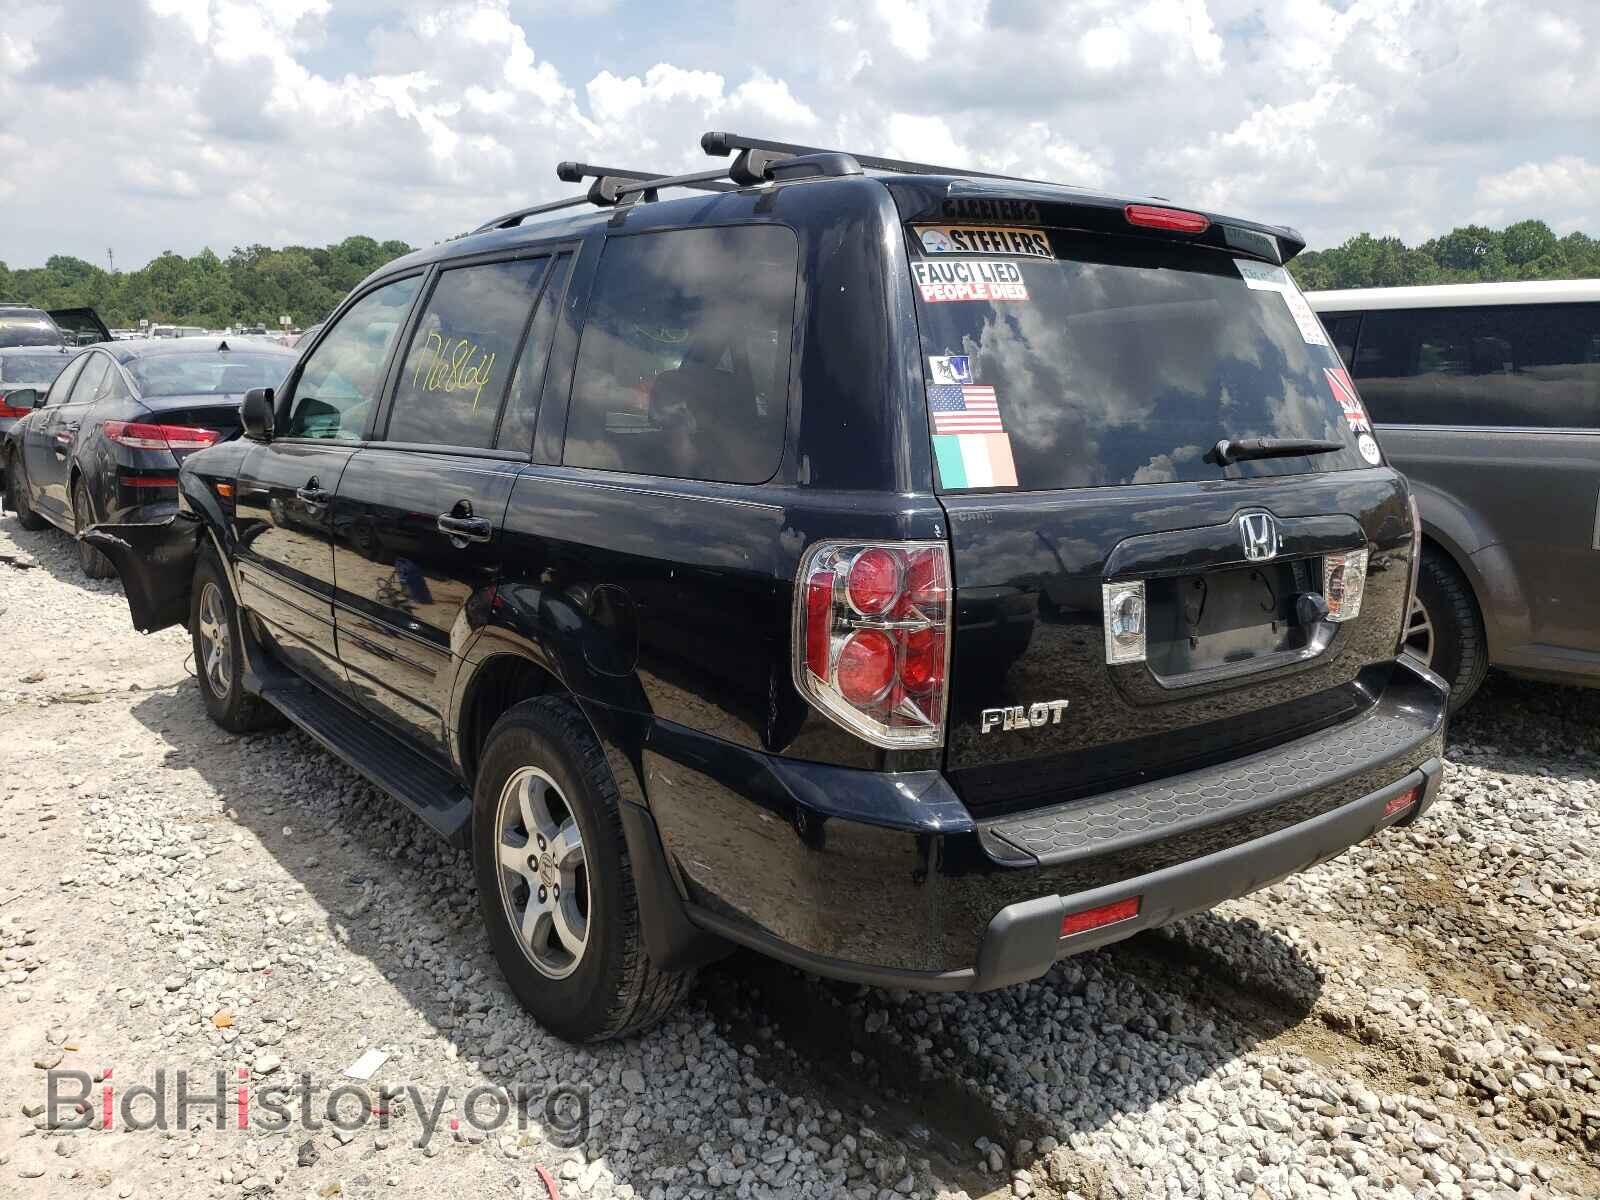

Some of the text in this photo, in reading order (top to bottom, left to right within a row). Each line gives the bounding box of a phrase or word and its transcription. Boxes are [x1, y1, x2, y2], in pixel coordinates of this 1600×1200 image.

[949, 230, 1051, 258] STEELERS
[914, 263, 1021, 284] FAUCI LIED
[920, 284, 1027, 300] PEOPLE DIED
[981, 699, 1070, 734] PILOT
